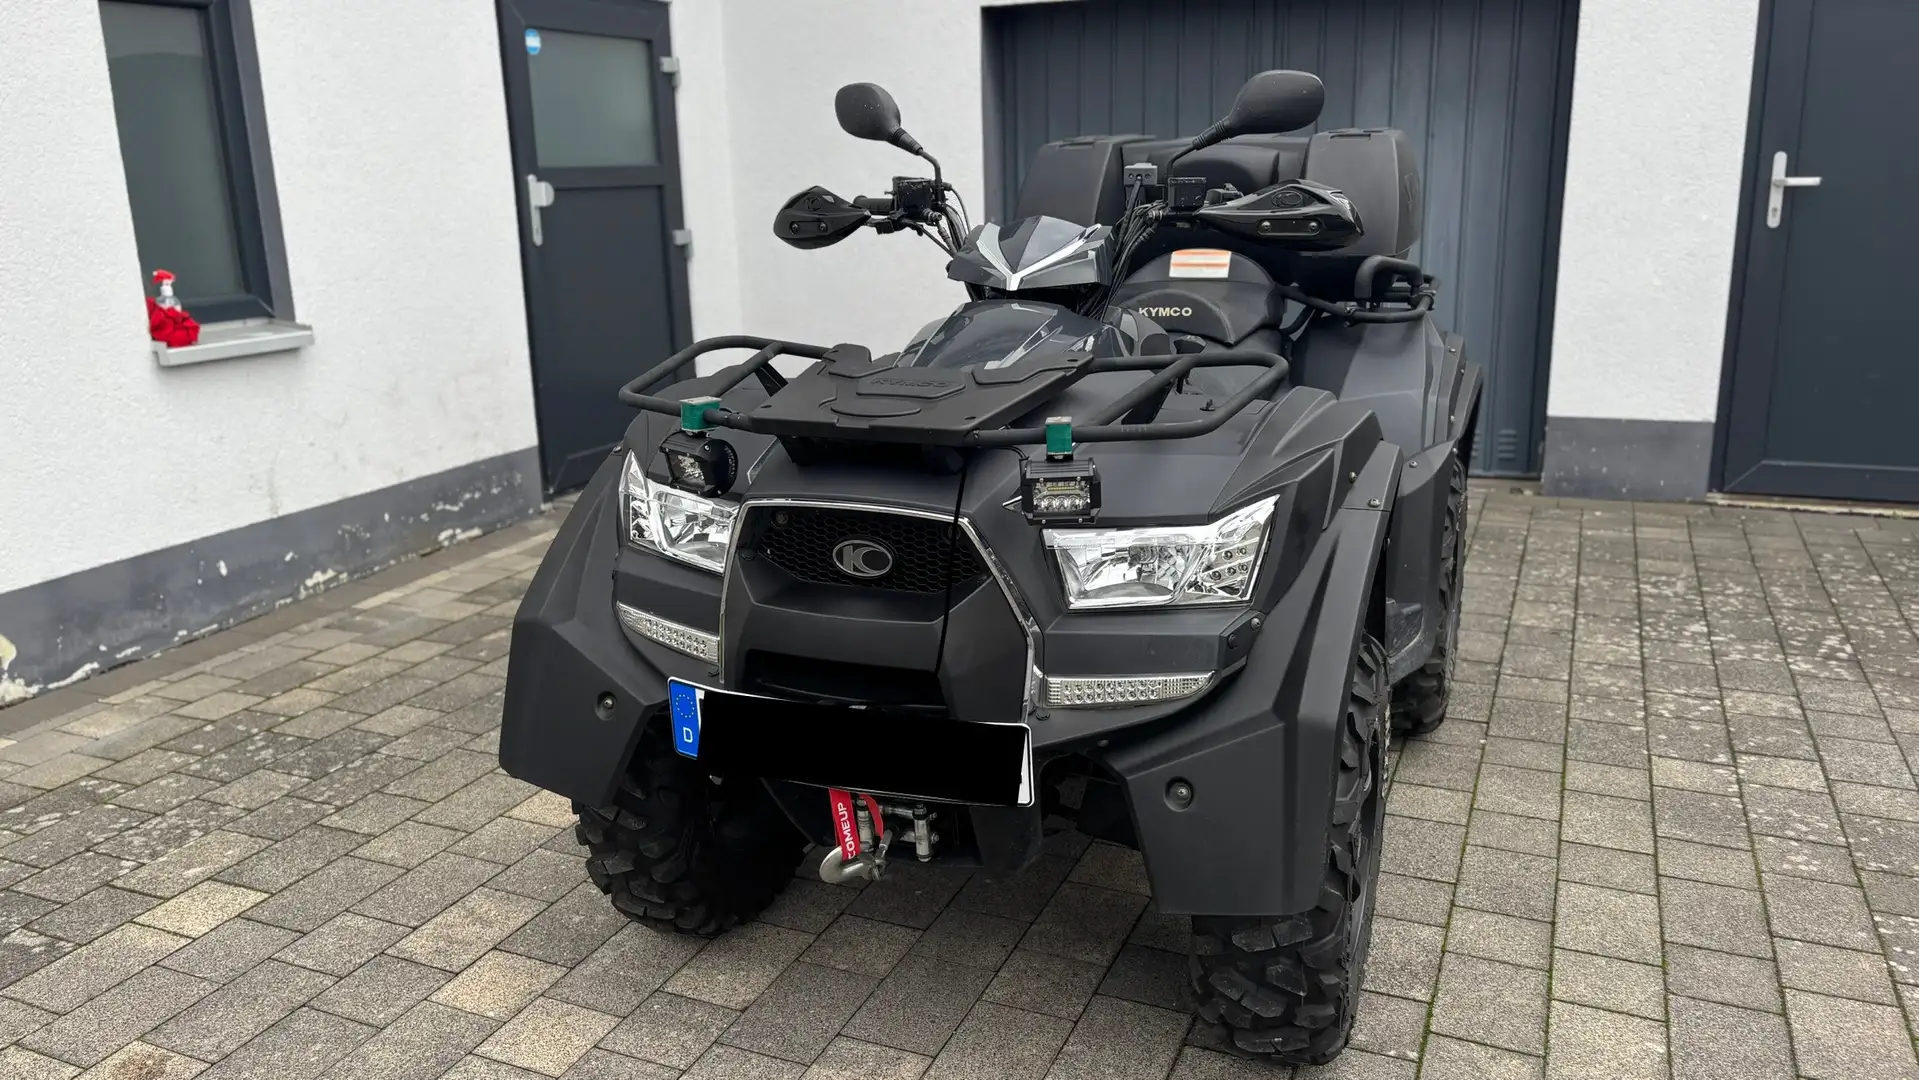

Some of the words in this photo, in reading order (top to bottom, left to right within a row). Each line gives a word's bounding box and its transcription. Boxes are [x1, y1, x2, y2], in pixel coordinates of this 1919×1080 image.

[1138, 306, 1193, 317] KYMCO
[683, 726, 694, 743] D
[837, 802, 857, 860] COMEUP
